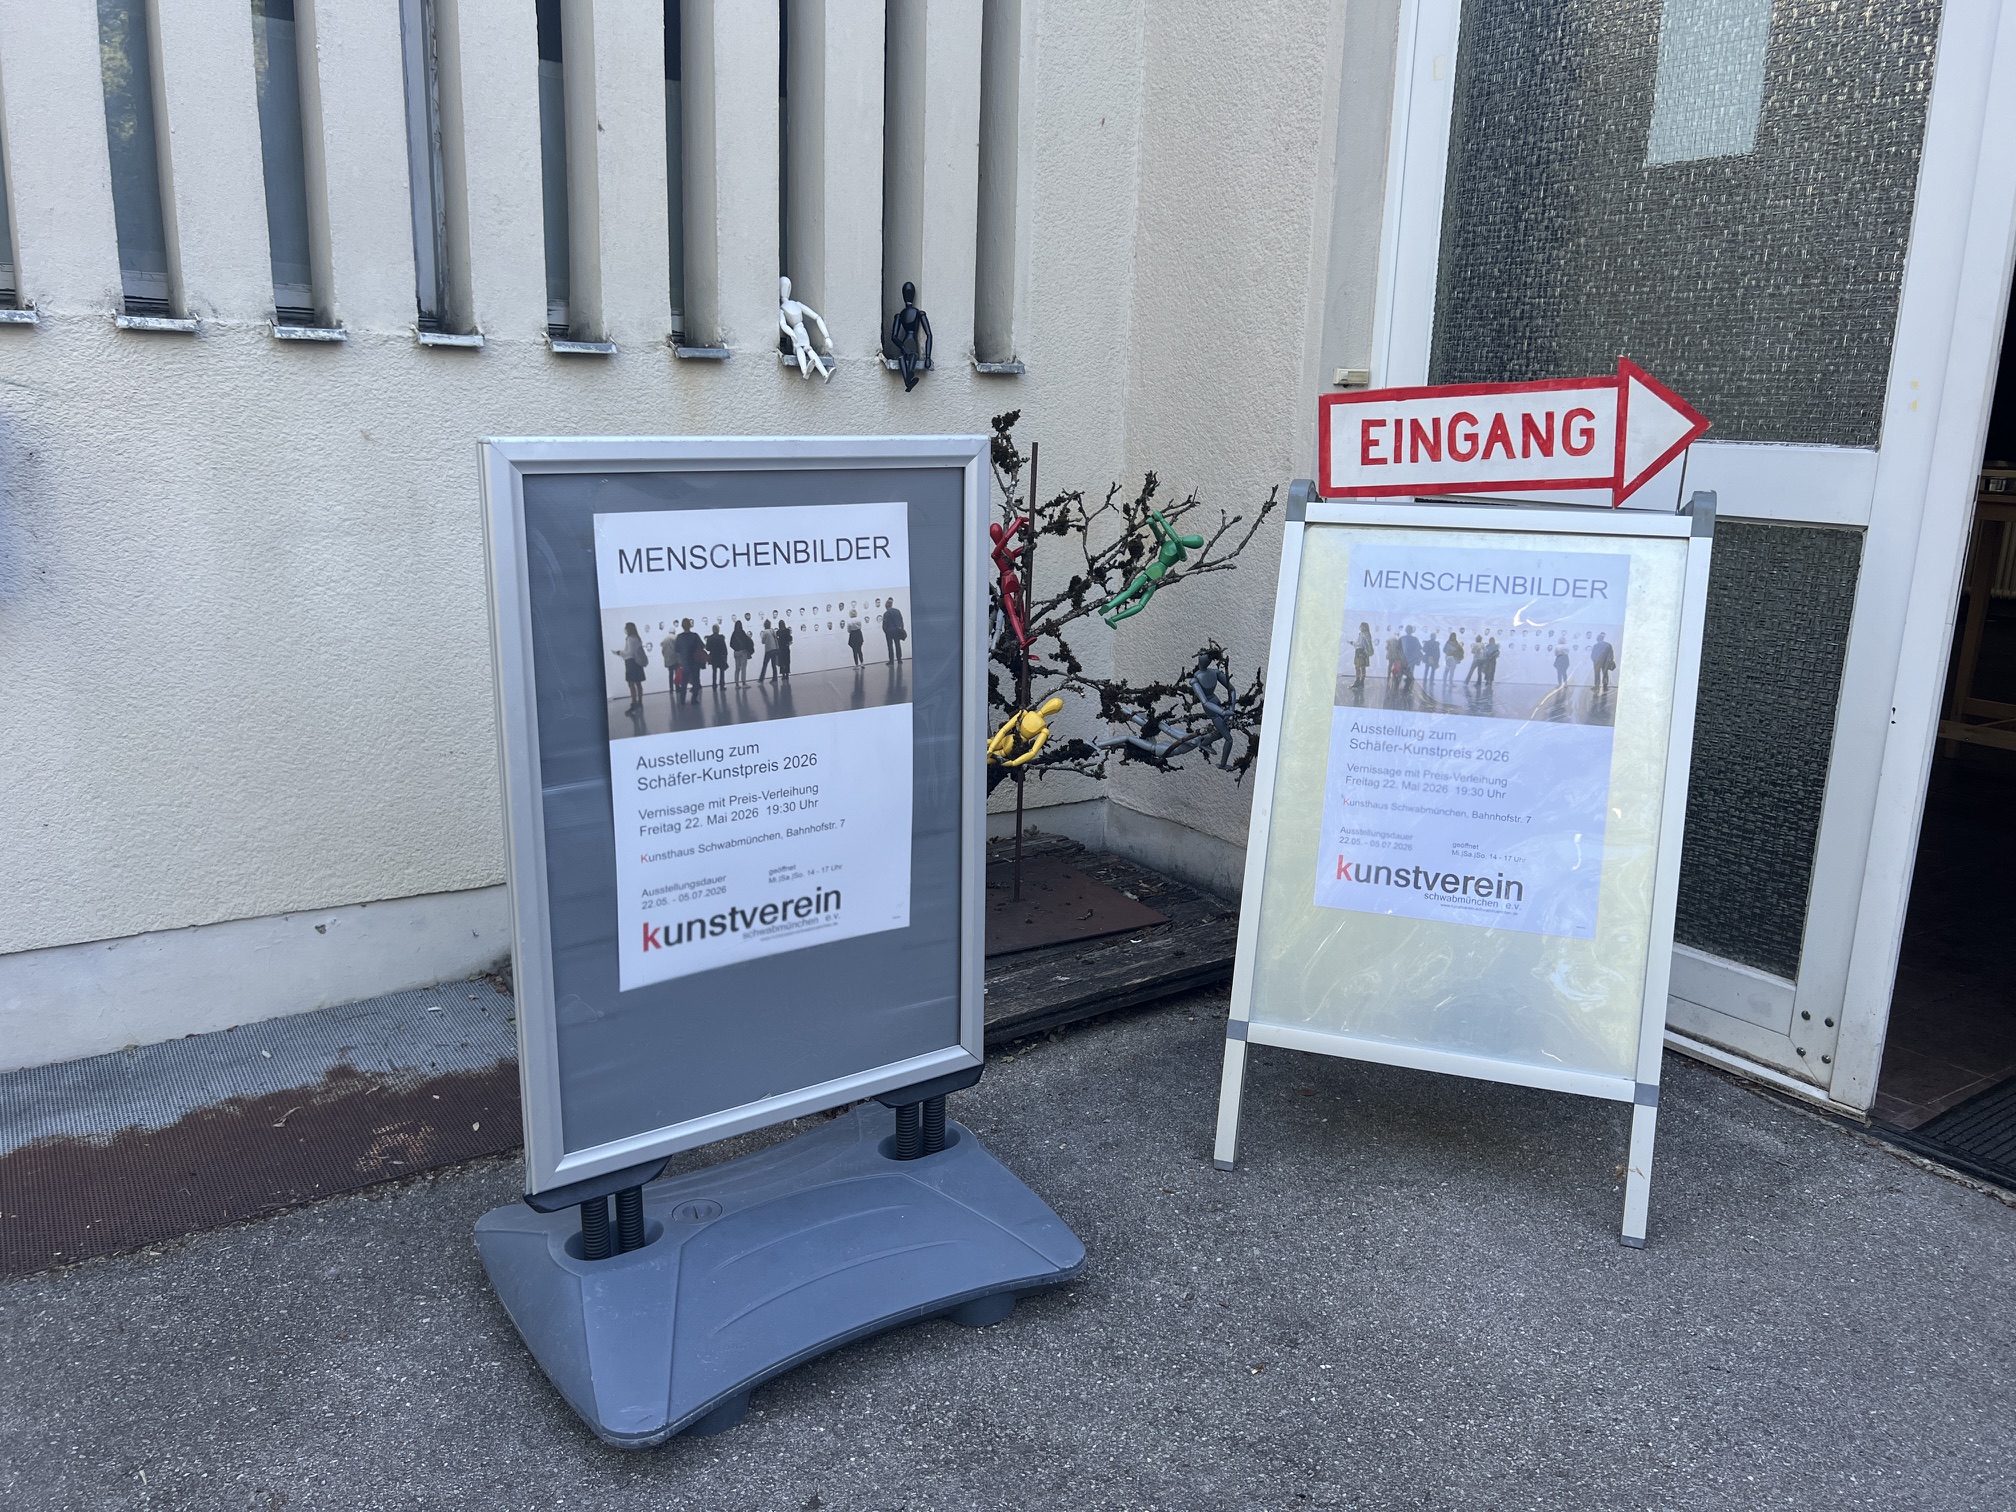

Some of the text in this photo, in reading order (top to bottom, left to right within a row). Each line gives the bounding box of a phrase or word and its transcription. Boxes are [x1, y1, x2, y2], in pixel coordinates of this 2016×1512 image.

[1361, 407, 1595, 466] EINGANG
[618, 535, 891, 575] MENSCHENBILDER
[1363, 569, 1608, 599] MENSCHENBILDER
[1350, 722, 1457, 741] Ausstellung zum
[636, 743, 760, 770] Ausstellung zum
[1349, 738, 1510, 763] Schäfer-Kunstpreis 2026
[637, 753, 818, 791] Schäfer-Kunstpreis 2026
[1347, 762, 1508, 788] Vernissage mit Preis-Verleihung
[1345, 776, 1507, 800] Freitag 22. Mai 2026 19:30 Uhr
[638, 784, 819, 820] Vernissage mit Preis-Verleihung
[1343, 797, 1532, 824] Kunsthaus Schwabmünchen, Bahnhofstr. 7
[639, 798, 819, 837] Freitag 22. Mai 2026 19:30 Uhr
[640, 819, 846, 864] Kunsthaus Schwabmünchen, Bahnhofstr. 7
[1340, 826, 1413, 841] Ausstellungsdauer
[1452, 842, 1479, 850] geöffnet
[830, 864, 843, 872] Uhr
[1336, 854, 1523, 901] kunstverein
[641, 874, 727, 898] Ausstellungsdauer
[1424, 892, 1522, 911] schwabmünchen e.v.
[642, 886, 841, 953] kunstverein
[743, 917, 819, 939] schwabmünchen
